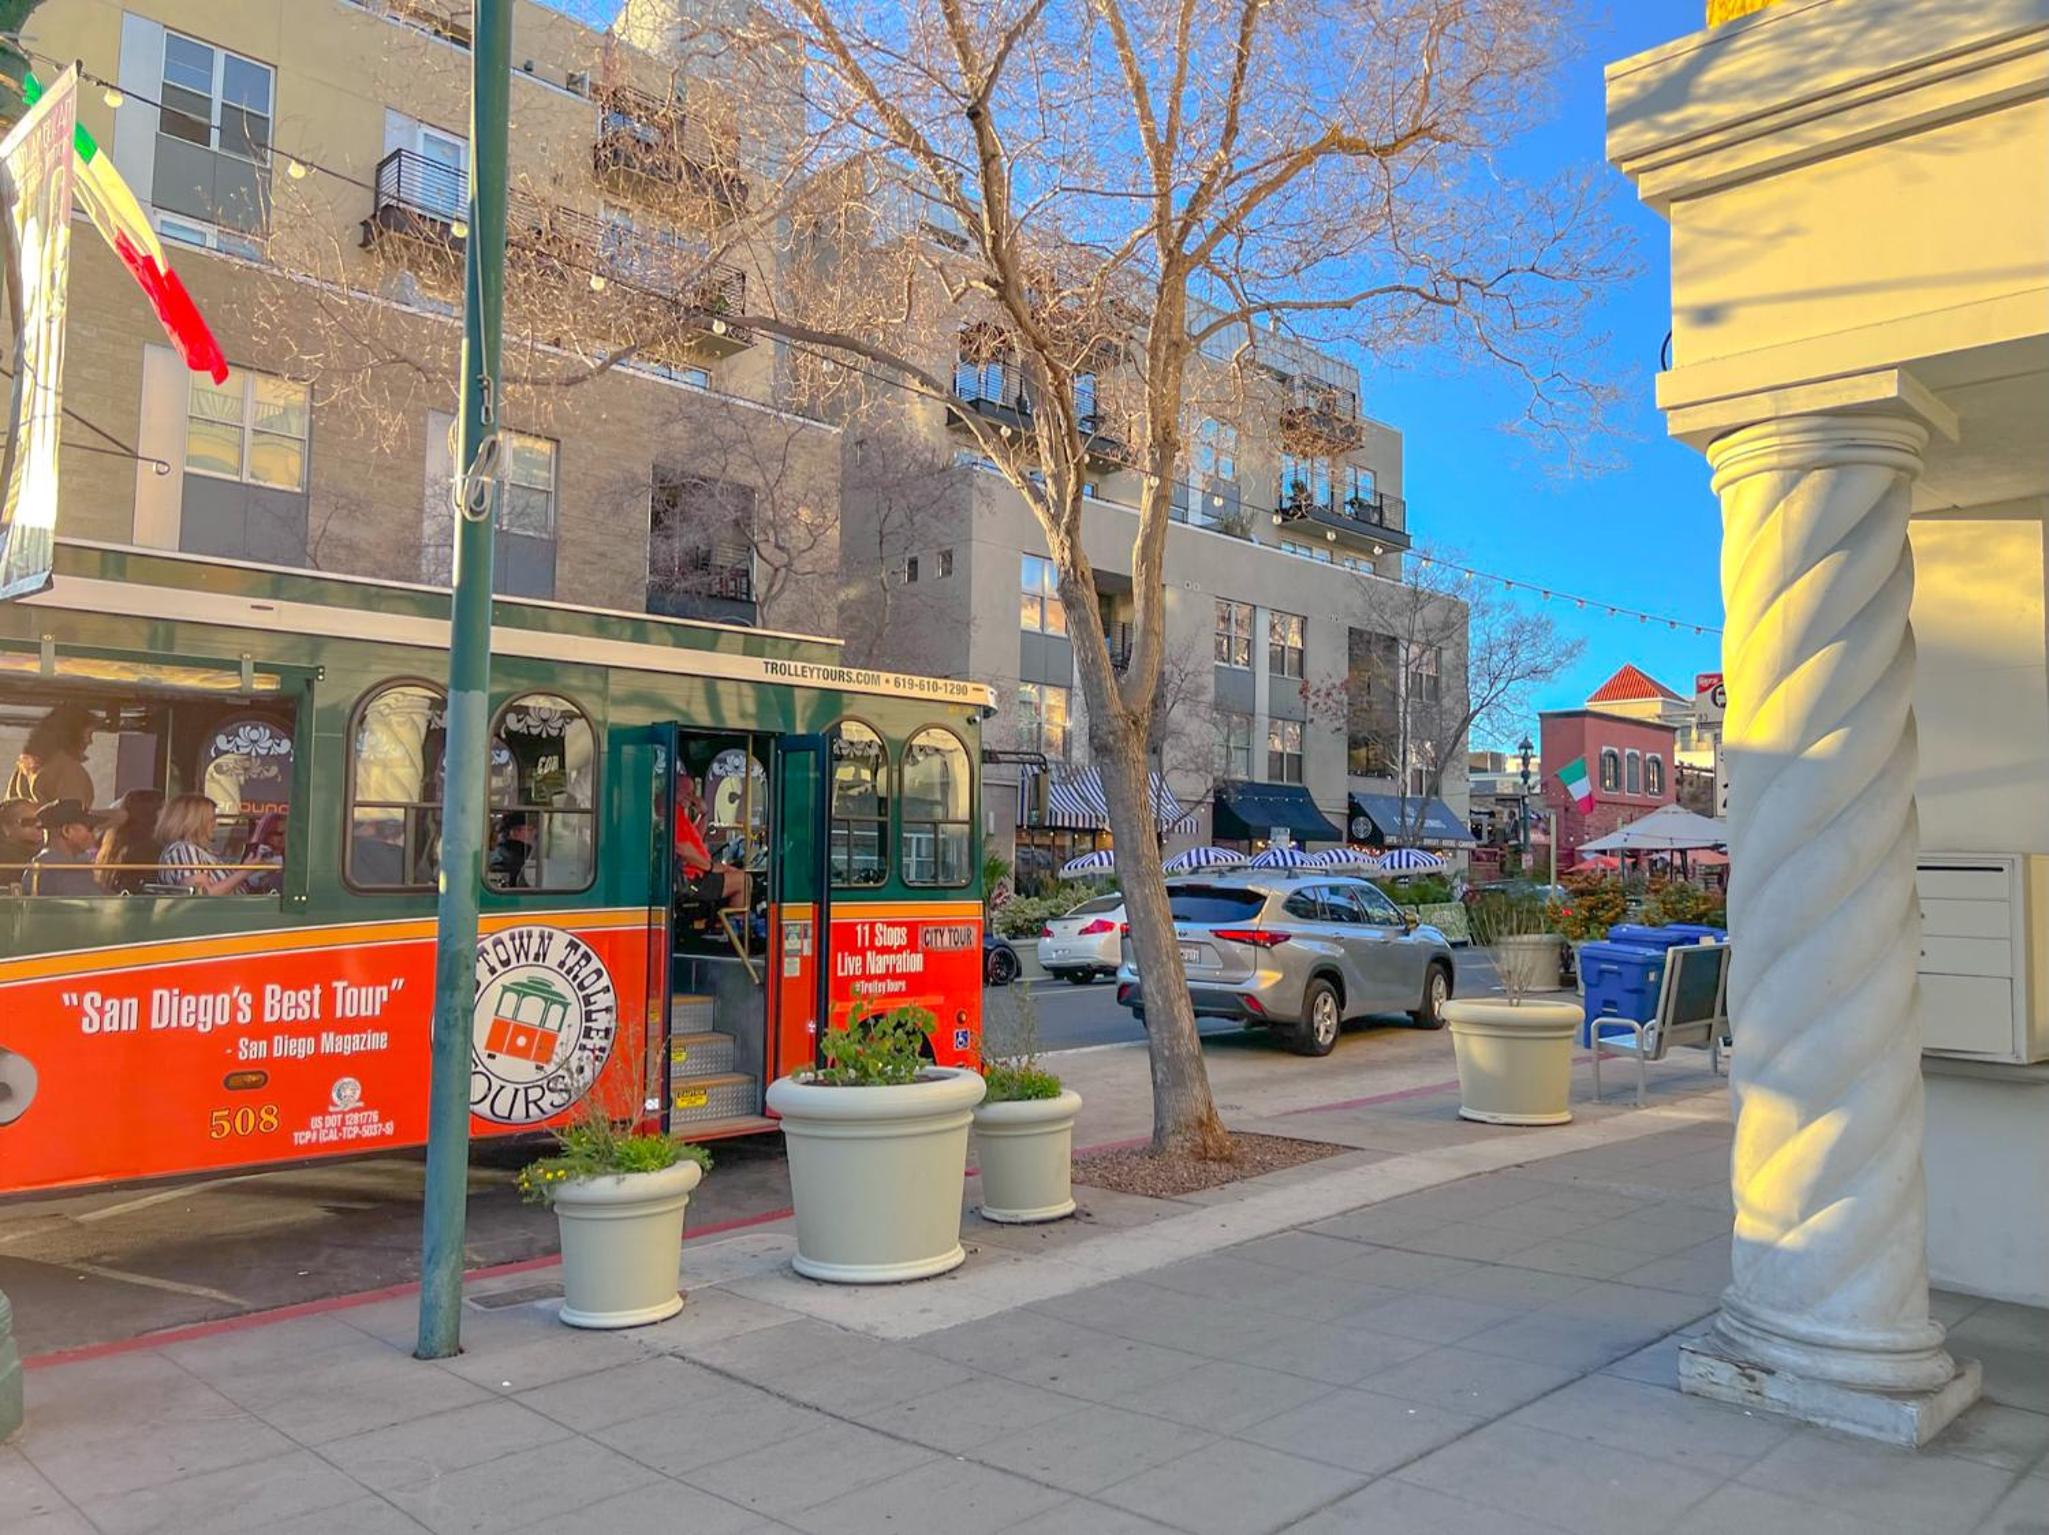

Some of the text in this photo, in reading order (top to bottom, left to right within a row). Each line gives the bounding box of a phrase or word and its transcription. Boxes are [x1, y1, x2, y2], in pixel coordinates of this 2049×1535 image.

[763, 661, 968, 696] TROLLEYTOURS.COM 619-610-1290
[856, 922, 908, 949] 11 Stops
[924, 927, 972, 946] CITY TOUR
[837, 950, 924, 976] Live Narration
[151, 985, 252, 1033] Diego's
[263, 983, 322, 1023] Best
[476, 929, 614, 1063] TOWN TROLLEY
[238, 1037, 267, 1060] San
[273, 1034, 315, 1060] Diego
[320, 1028, 389, 1055] Magazine
[471, 1062, 573, 1120] OURS
[210, 1104, 280, 1140] 508
[310, 1115, 323, 1130] US
[325, 1114, 343, 1128] DOT
